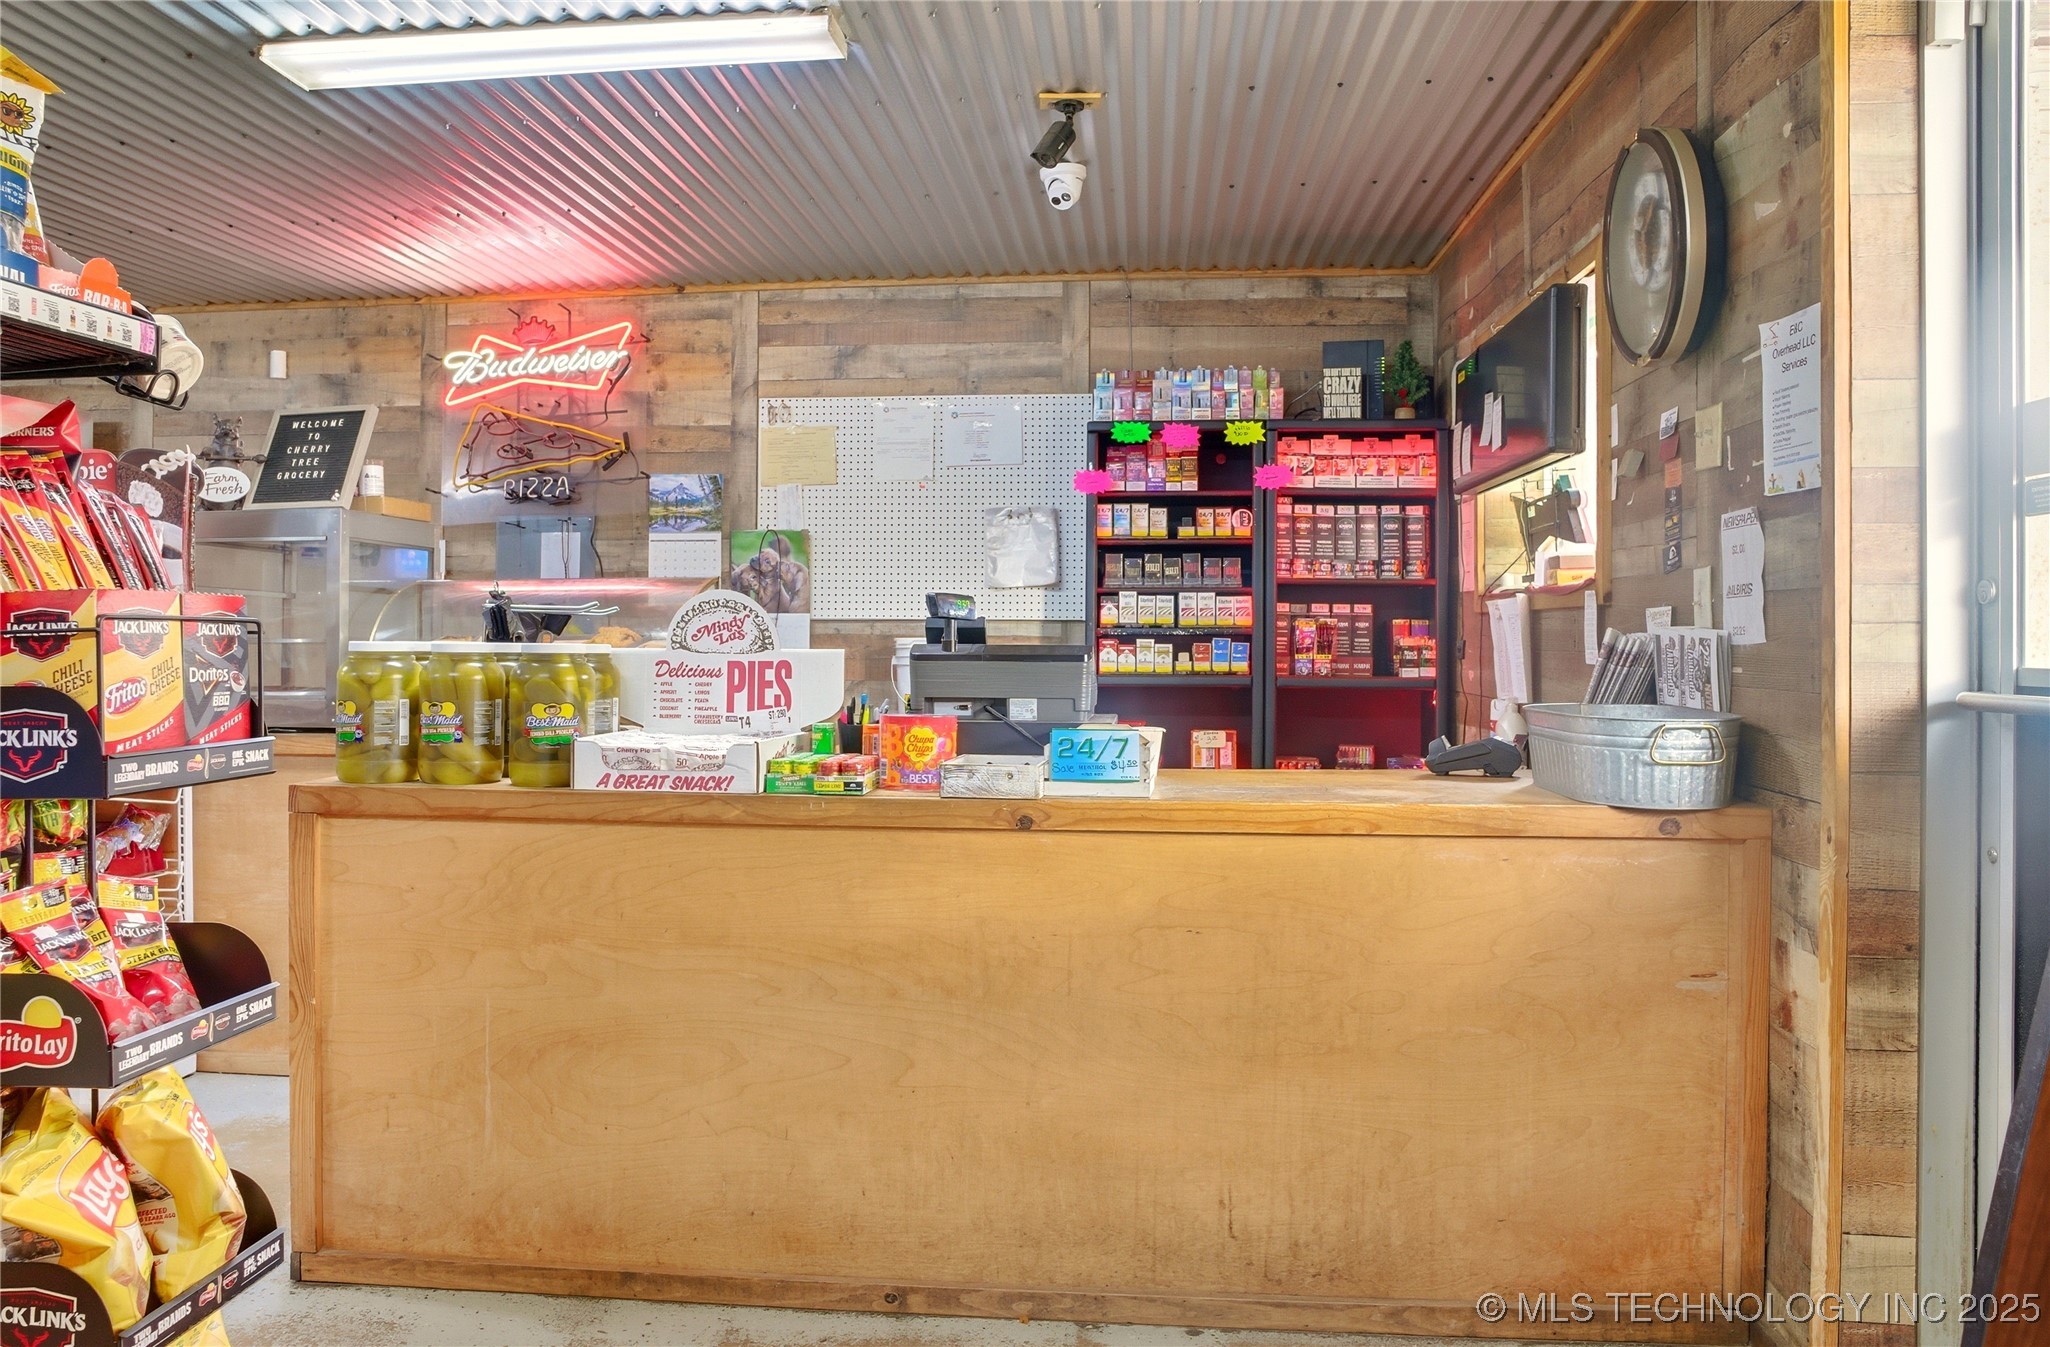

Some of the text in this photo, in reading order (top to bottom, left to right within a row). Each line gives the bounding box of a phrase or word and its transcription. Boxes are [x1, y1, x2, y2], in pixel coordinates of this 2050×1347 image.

[1772, 333, 1817, 360] Overhead LLC
[444, 346, 628, 384] Budweiser
[1781, 356, 1808, 374] Services
[1323, 376, 1361, 394] CRAZY
[292, 418, 345, 429] WELCOME
[308, 433, 321, 441] TO
[287, 444, 331, 455] CHERRY
[291, 457, 320, 467] TREE
[205, 472, 239, 483] Farm
[277, 470, 326, 480] GROCERY
[205, 483, 244, 496] Fresh
[504, 476, 570, 498] PIZZA
[112, 620, 169, 634] JACK LINK'S
[196, 623, 241, 636] JACK LINK'S
[691, 614, 750, 642] Mindy
[52, 659, 83, 684] CHILI
[151, 656, 174, 679] CHILI
[189, 667, 229, 683] Doritos
[52, 670, 94, 695] HEESE
[150, 667, 181, 696] CHEESE
[655, 660, 792, 713] Delicious PIES
[105, 678, 147, 713] Fritos
[200, 712, 243, 744] MEAT STICKS
[434, 715, 463, 726] Maid
[526, 715, 579, 727] Best Maid
[22, 728, 78, 749] LINK'S
[116, 715, 175, 753] MEAT STICKS
[908, 735, 934, 744] Chupa
[232, 750, 243, 758] ONE
[245, 748, 269, 762] SNACK
[906, 743, 934, 754] Chups
[1057, 735, 1128, 761] 24/7
[120, 762, 139, 773] TWO
[145, 761, 179, 777] BRANDS
[232, 757, 245, 767] EPIC
[1052, 762, 1074, 774] Sale
[114, 770, 146, 784] LEGENDARY
[596, 773, 735, 791] A GREAT SNACK!
[909, 774, 933, 784] BEST
[114, 925, 137, 937] JACK
[36, 938, 61, 954] JACK
[236, 1003, 248, 1014] ONE
[249, 995, 272, 1016] SNACK
[236, 1011, 249, 1024] EPIC
[125, 1044, 143, 1059] TWO
[150, 1032, 184, 1057] BRANDS
[118, 1051, 150, 1072] LEGENDARY
[256, 1240, 281, 1267] SNACK
[243, 1256, 256, 1269] ONE
[243, 1265, 258, 1279] EPIC
[29, 1306, 87, 1332] LINK'S
[157, 1302, 192, 1335] BRANDS
[133, 1325, 153, 1343] TWO
